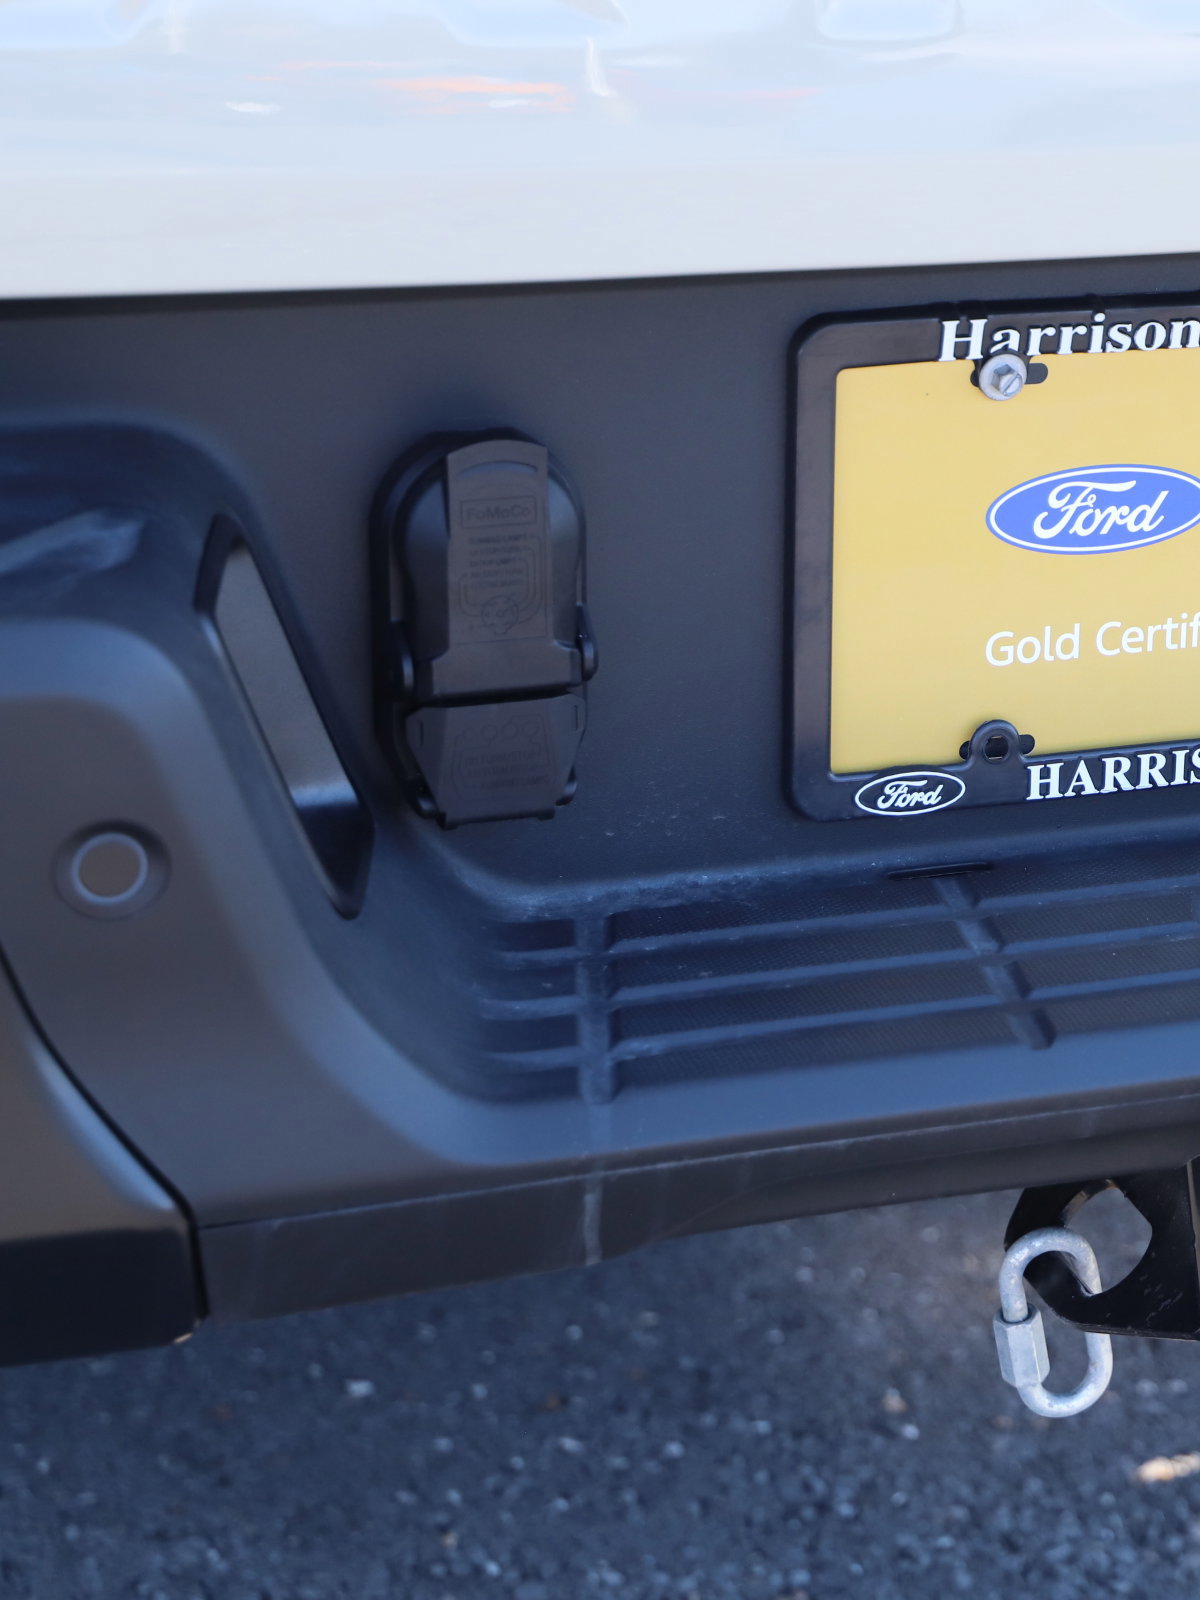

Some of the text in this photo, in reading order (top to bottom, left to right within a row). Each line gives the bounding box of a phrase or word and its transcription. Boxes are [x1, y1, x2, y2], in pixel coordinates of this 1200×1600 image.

[466, 504, 531, 520] FoMoCo
[1033, 481, 1168, 538] Ford
[985, 623, 1081, 666] Gold
